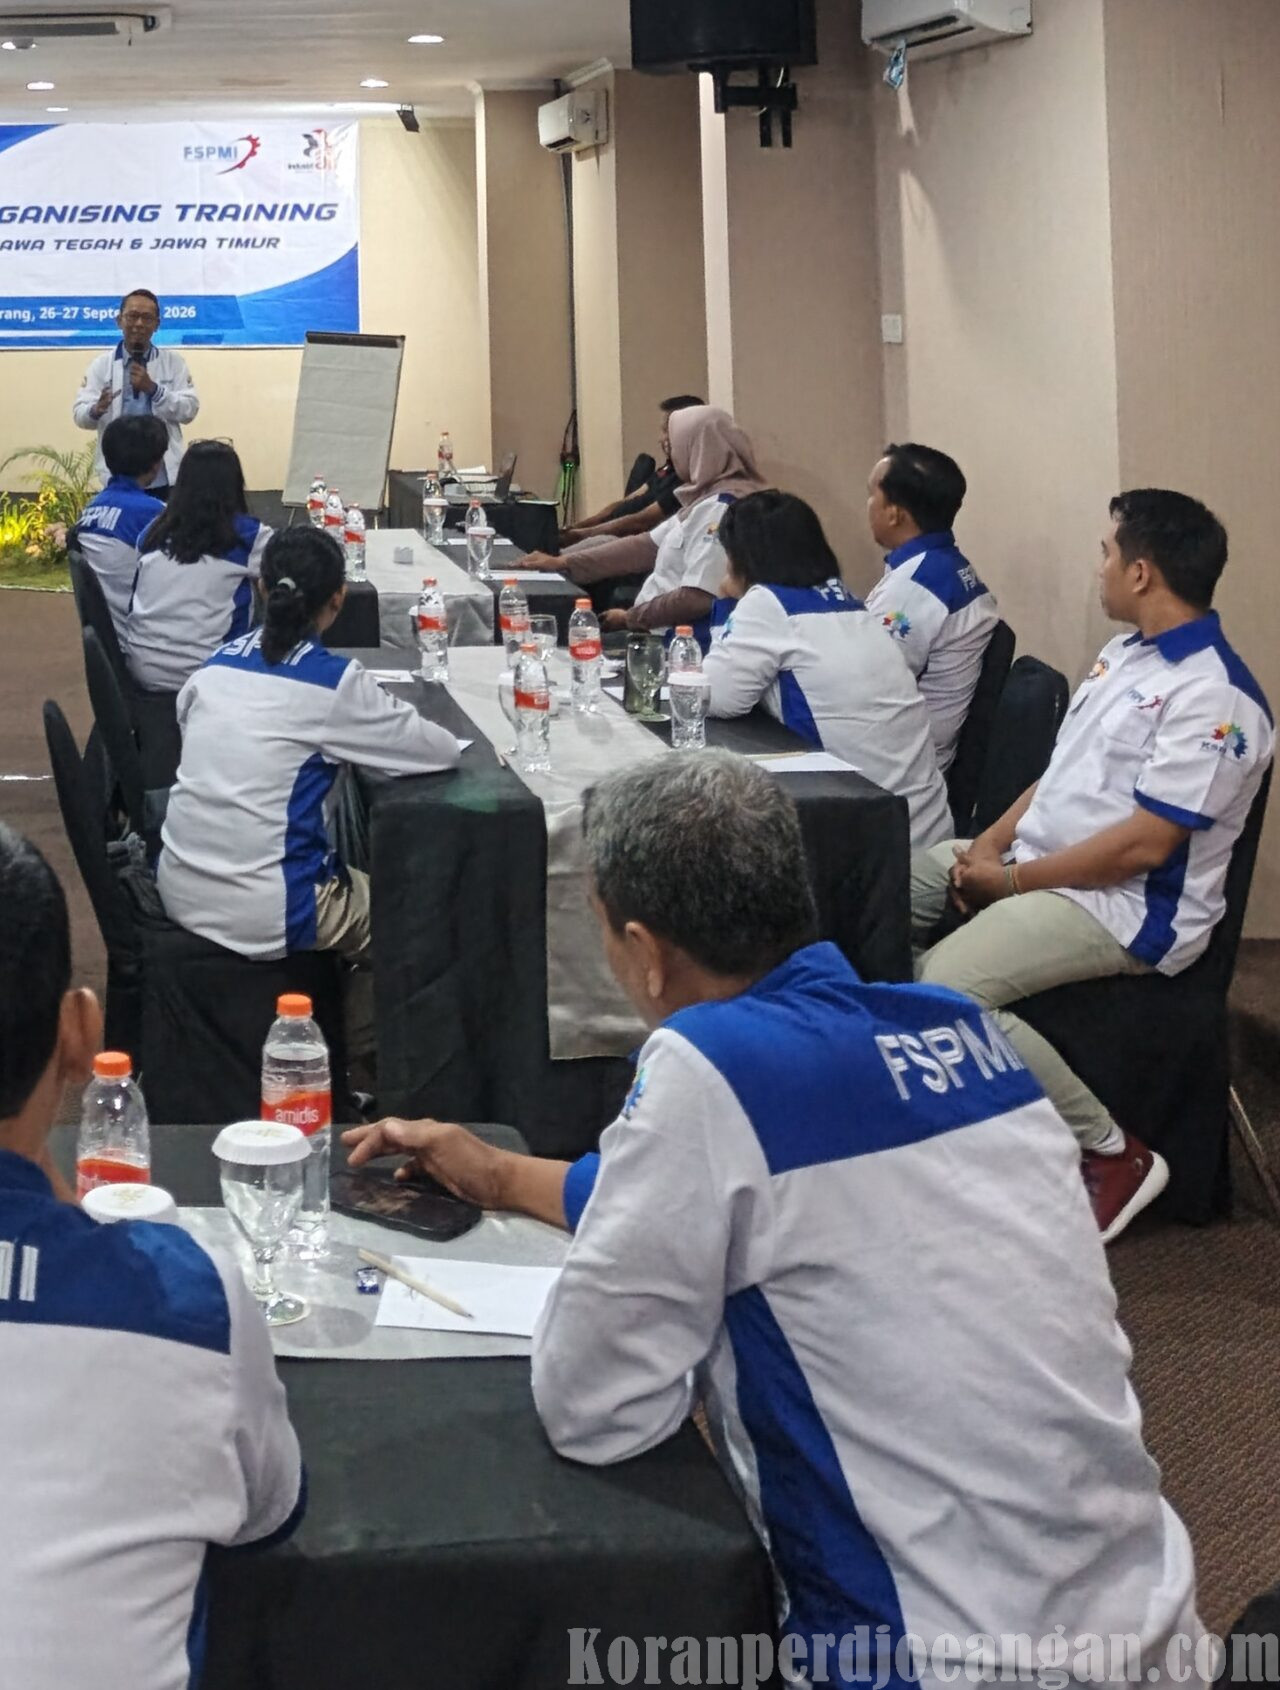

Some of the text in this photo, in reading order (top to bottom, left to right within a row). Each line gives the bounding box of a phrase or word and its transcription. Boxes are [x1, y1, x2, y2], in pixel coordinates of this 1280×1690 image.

[183, 146, 238, 159] FSPMI
[176, 203, 338, 222] TRAINING
[54, 238, 123, 250] TEGAH
[130, 238, 143, 250] &
[149, 237, 207, 250] JAWA
[216, 237, 281, 249] TIMUR
[83, 307, 123, 321] Septe
[163, 306, 196, 318] 2026
[874, 1012, 1025, 1101] FSPM
[275, 1106, 319, 1124] amidis
